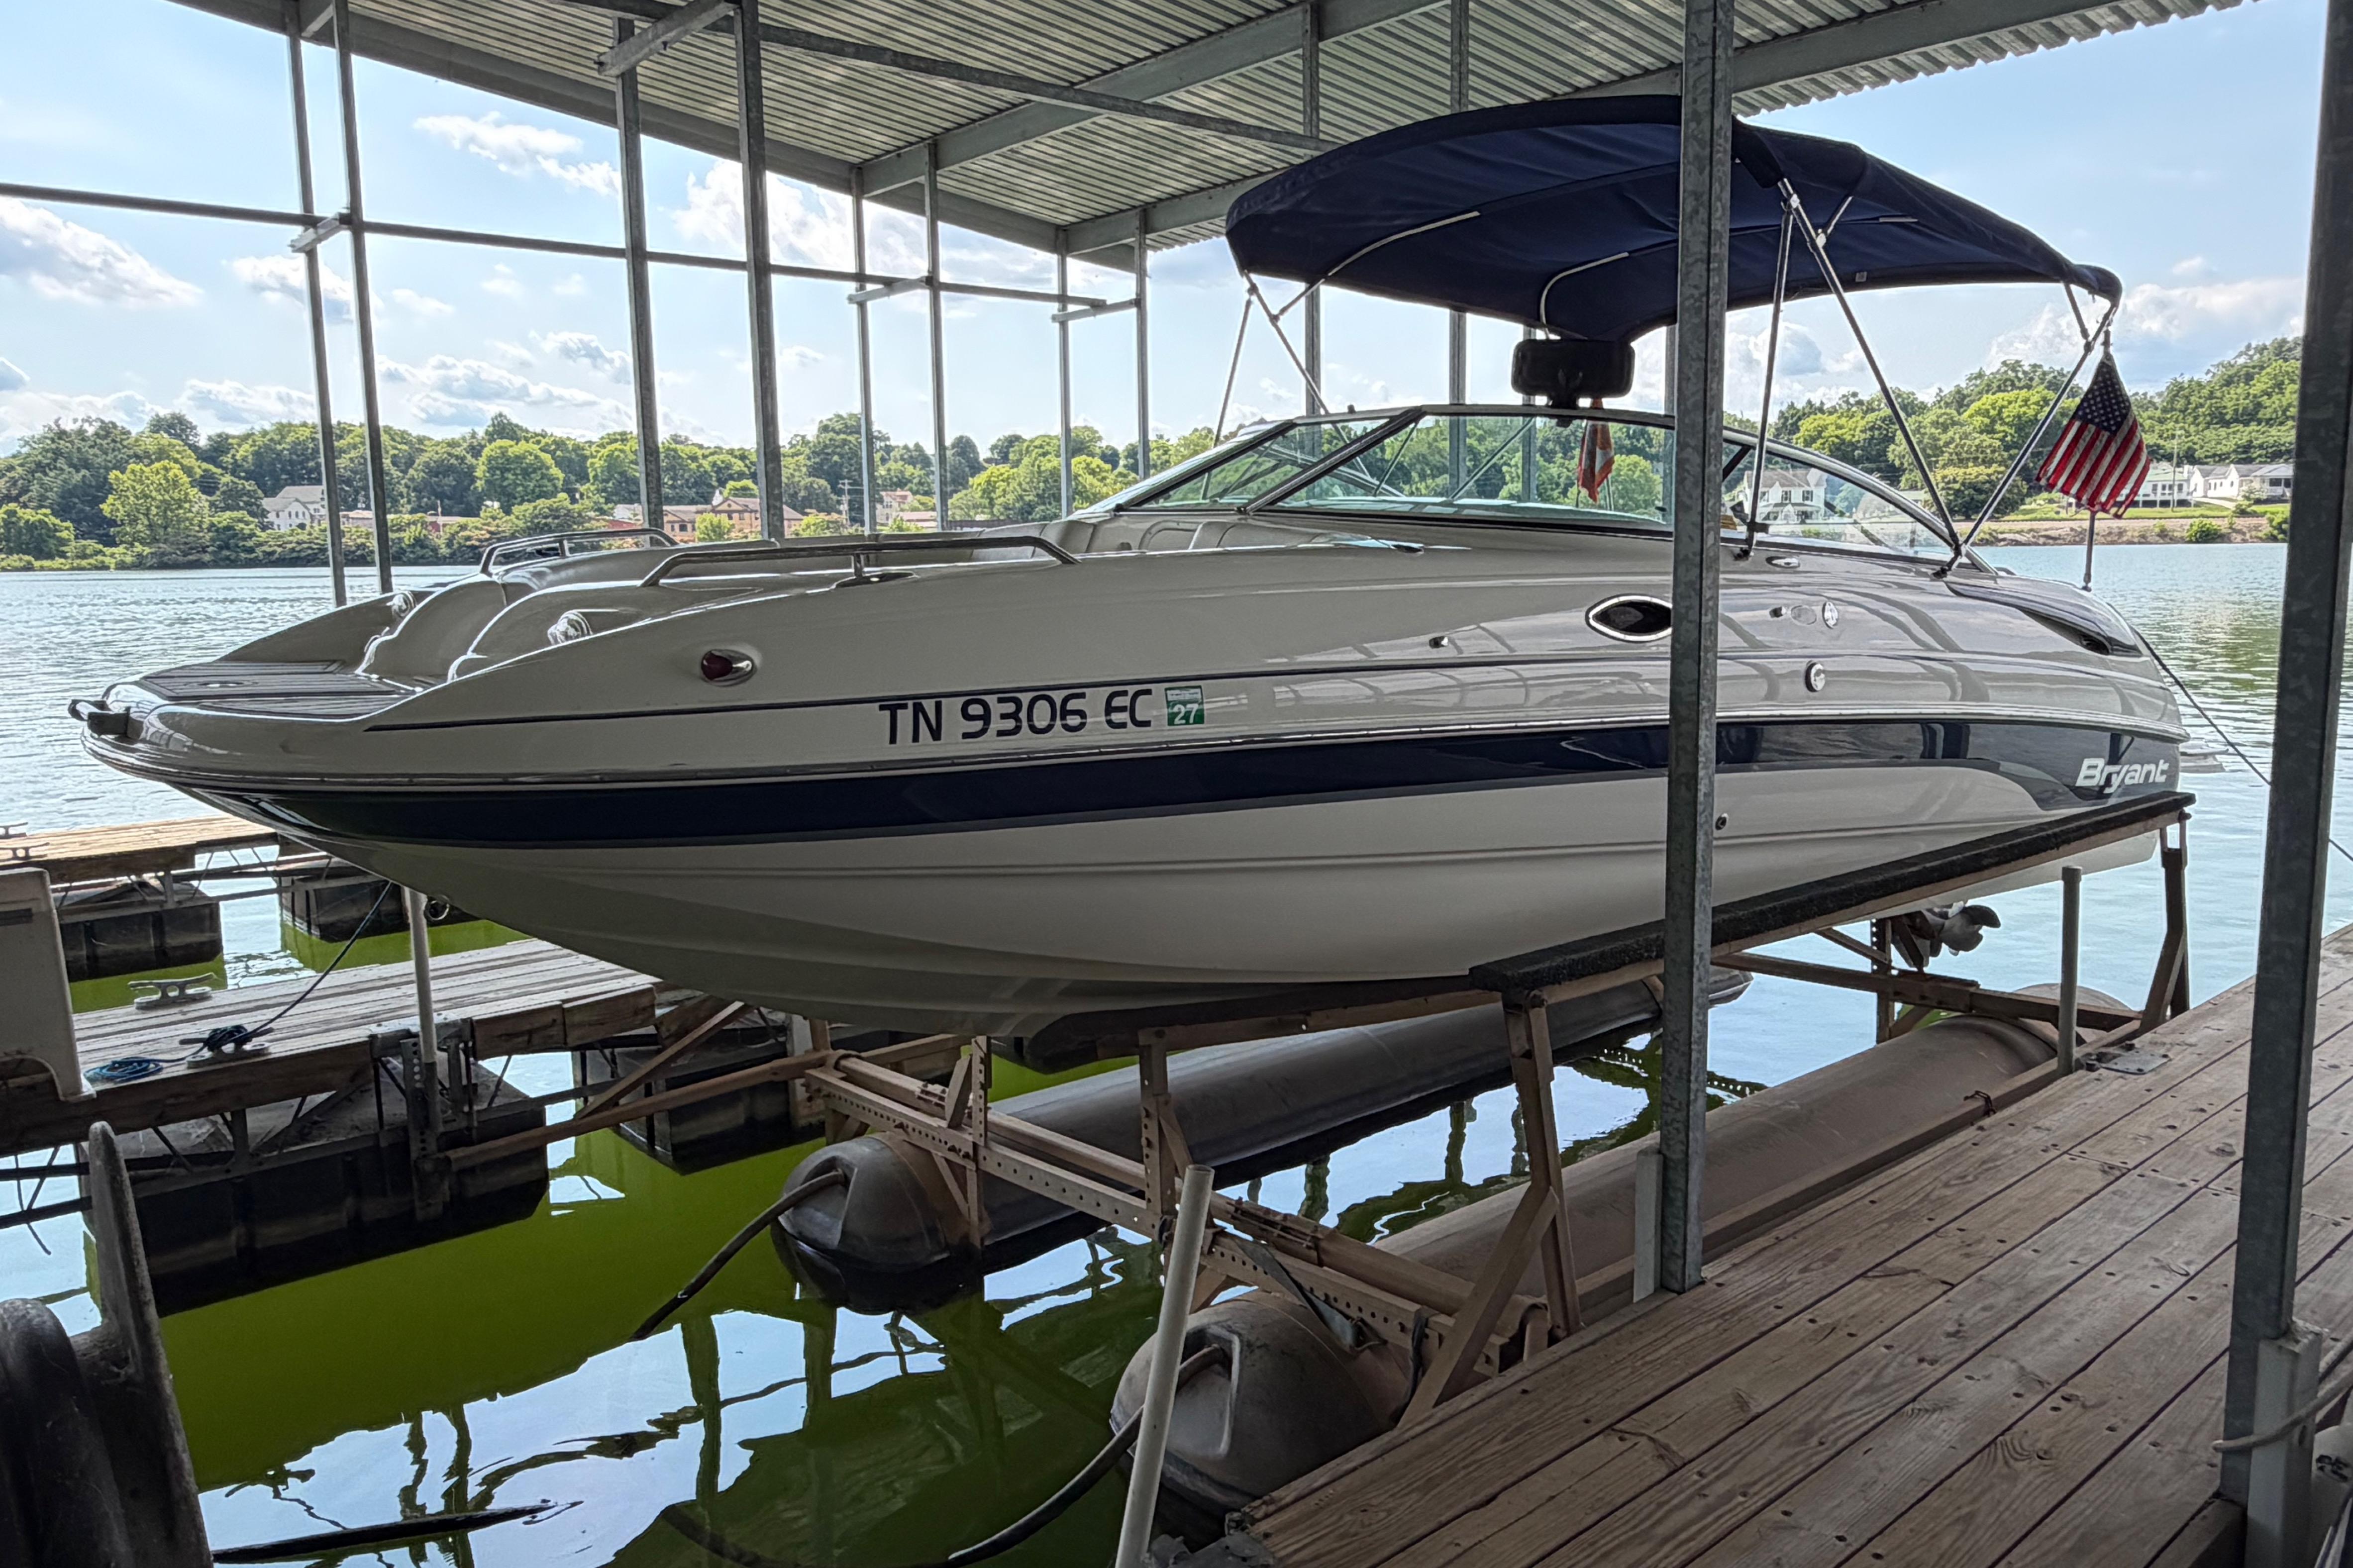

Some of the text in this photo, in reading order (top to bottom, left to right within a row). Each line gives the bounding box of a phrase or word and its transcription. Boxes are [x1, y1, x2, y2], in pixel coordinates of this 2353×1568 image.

[878, 689, 1152, 745] TN 9306 EC
[1174, 703, 1199, 724] 27
[2075, 758, 2169, 793] Bryant
